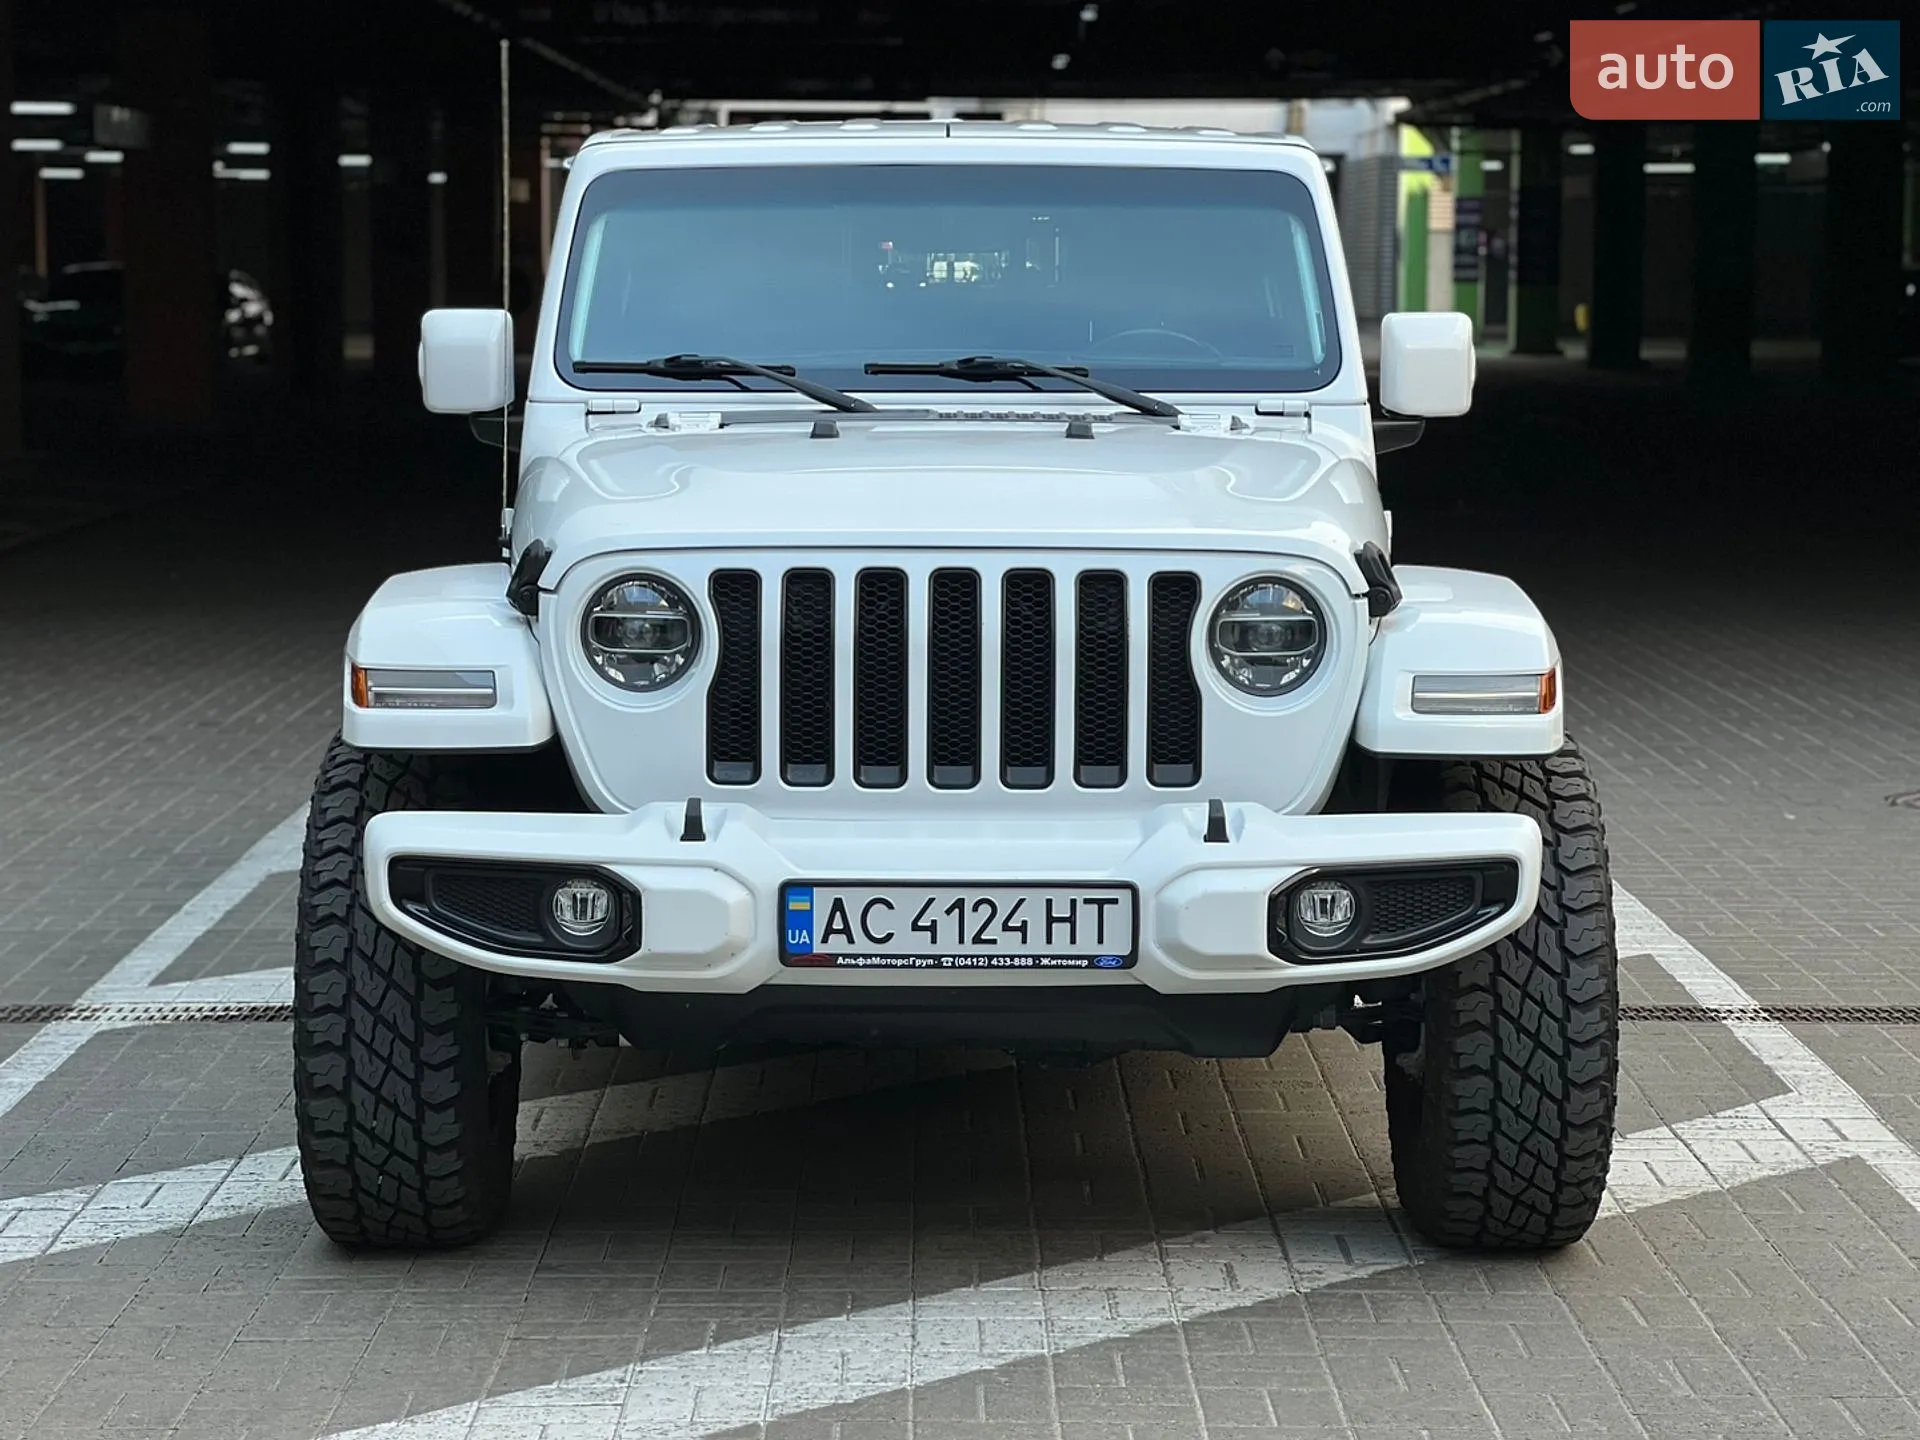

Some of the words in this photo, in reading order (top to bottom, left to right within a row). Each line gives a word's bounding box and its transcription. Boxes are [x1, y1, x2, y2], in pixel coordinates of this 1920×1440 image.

[820, 896, 896, 945] AC
[910, 896, 1028, 945] 4124
[1045, 896, 1119, 946] HT
[787, 929, 811, 945] UA
[954, 956, 988, 968] (0412)
[990, 957, 1033, 967] 433-888
